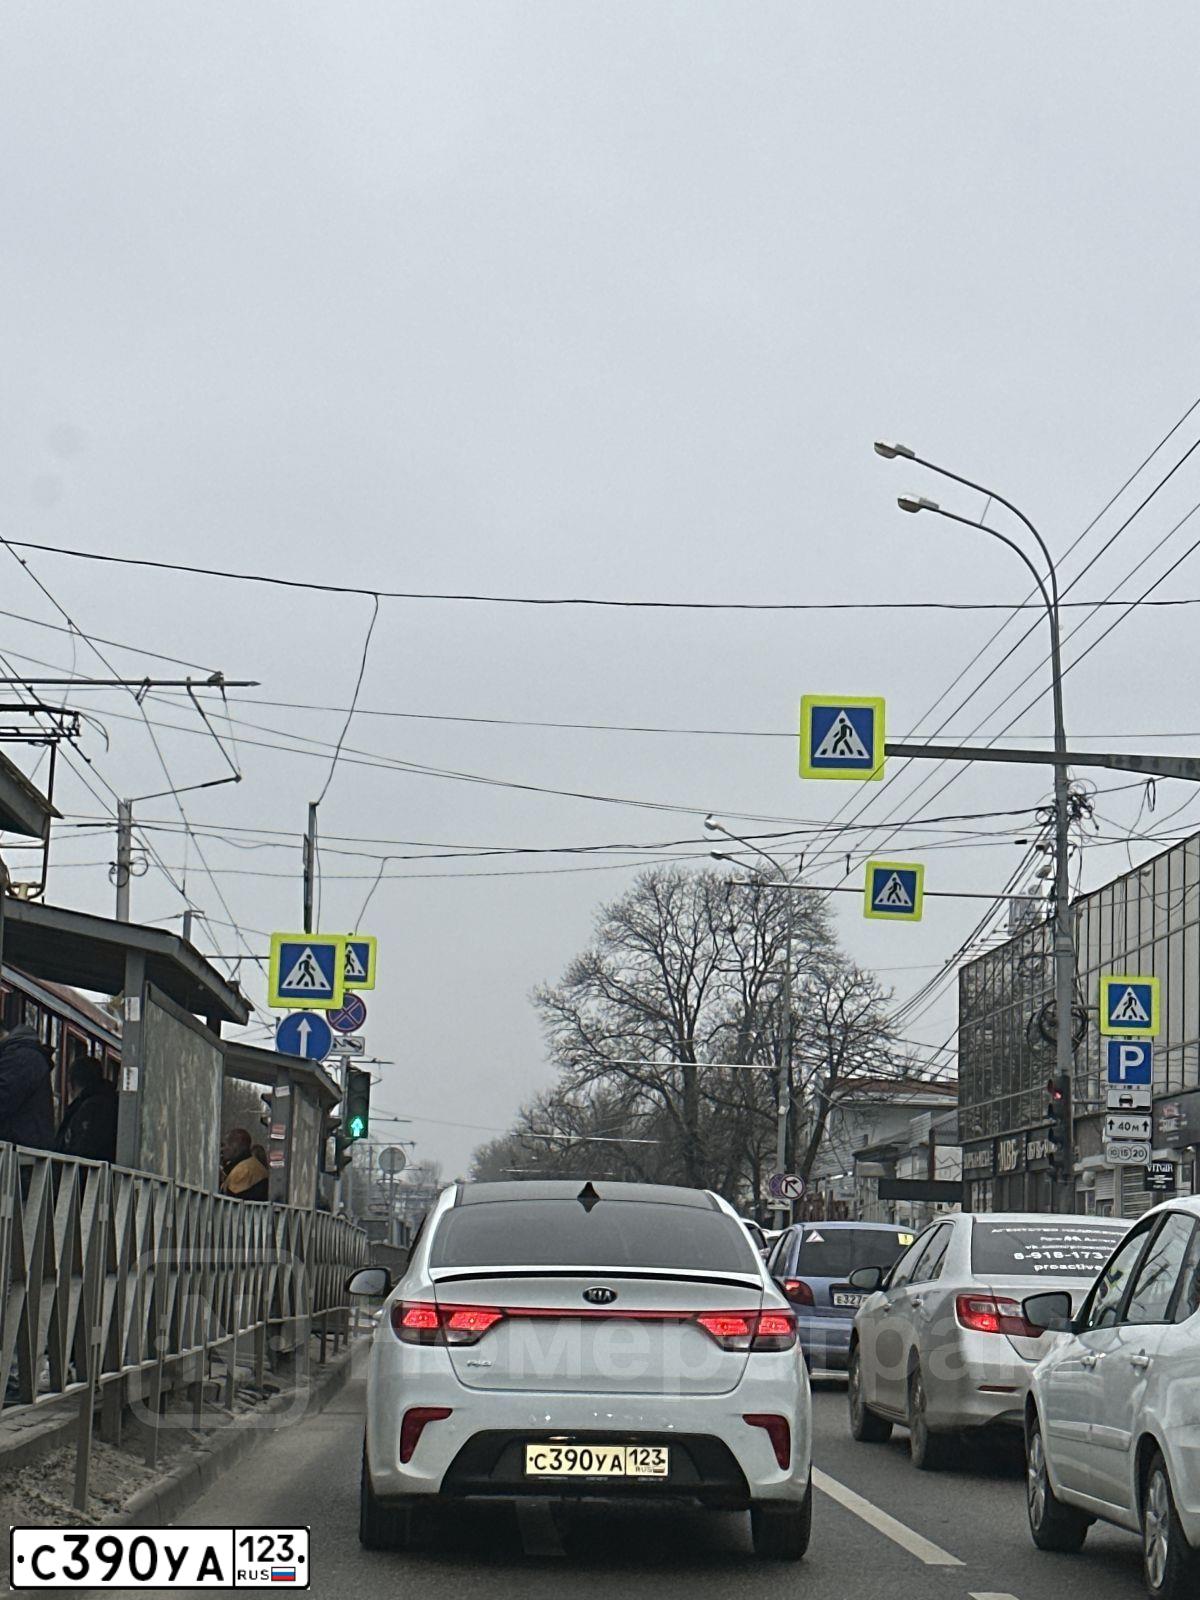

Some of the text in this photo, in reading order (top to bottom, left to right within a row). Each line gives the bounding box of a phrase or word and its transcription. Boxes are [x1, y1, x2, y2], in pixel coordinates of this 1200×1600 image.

[1119, 1045, 1145, 1080] P
[1117, 1121, 1131, 1131] 40
[1132, 1147, 1145, 1157] 20
[588, 1290, 613, 1300] KIA
[534, 1448, 662, 1472] С390УА 123
